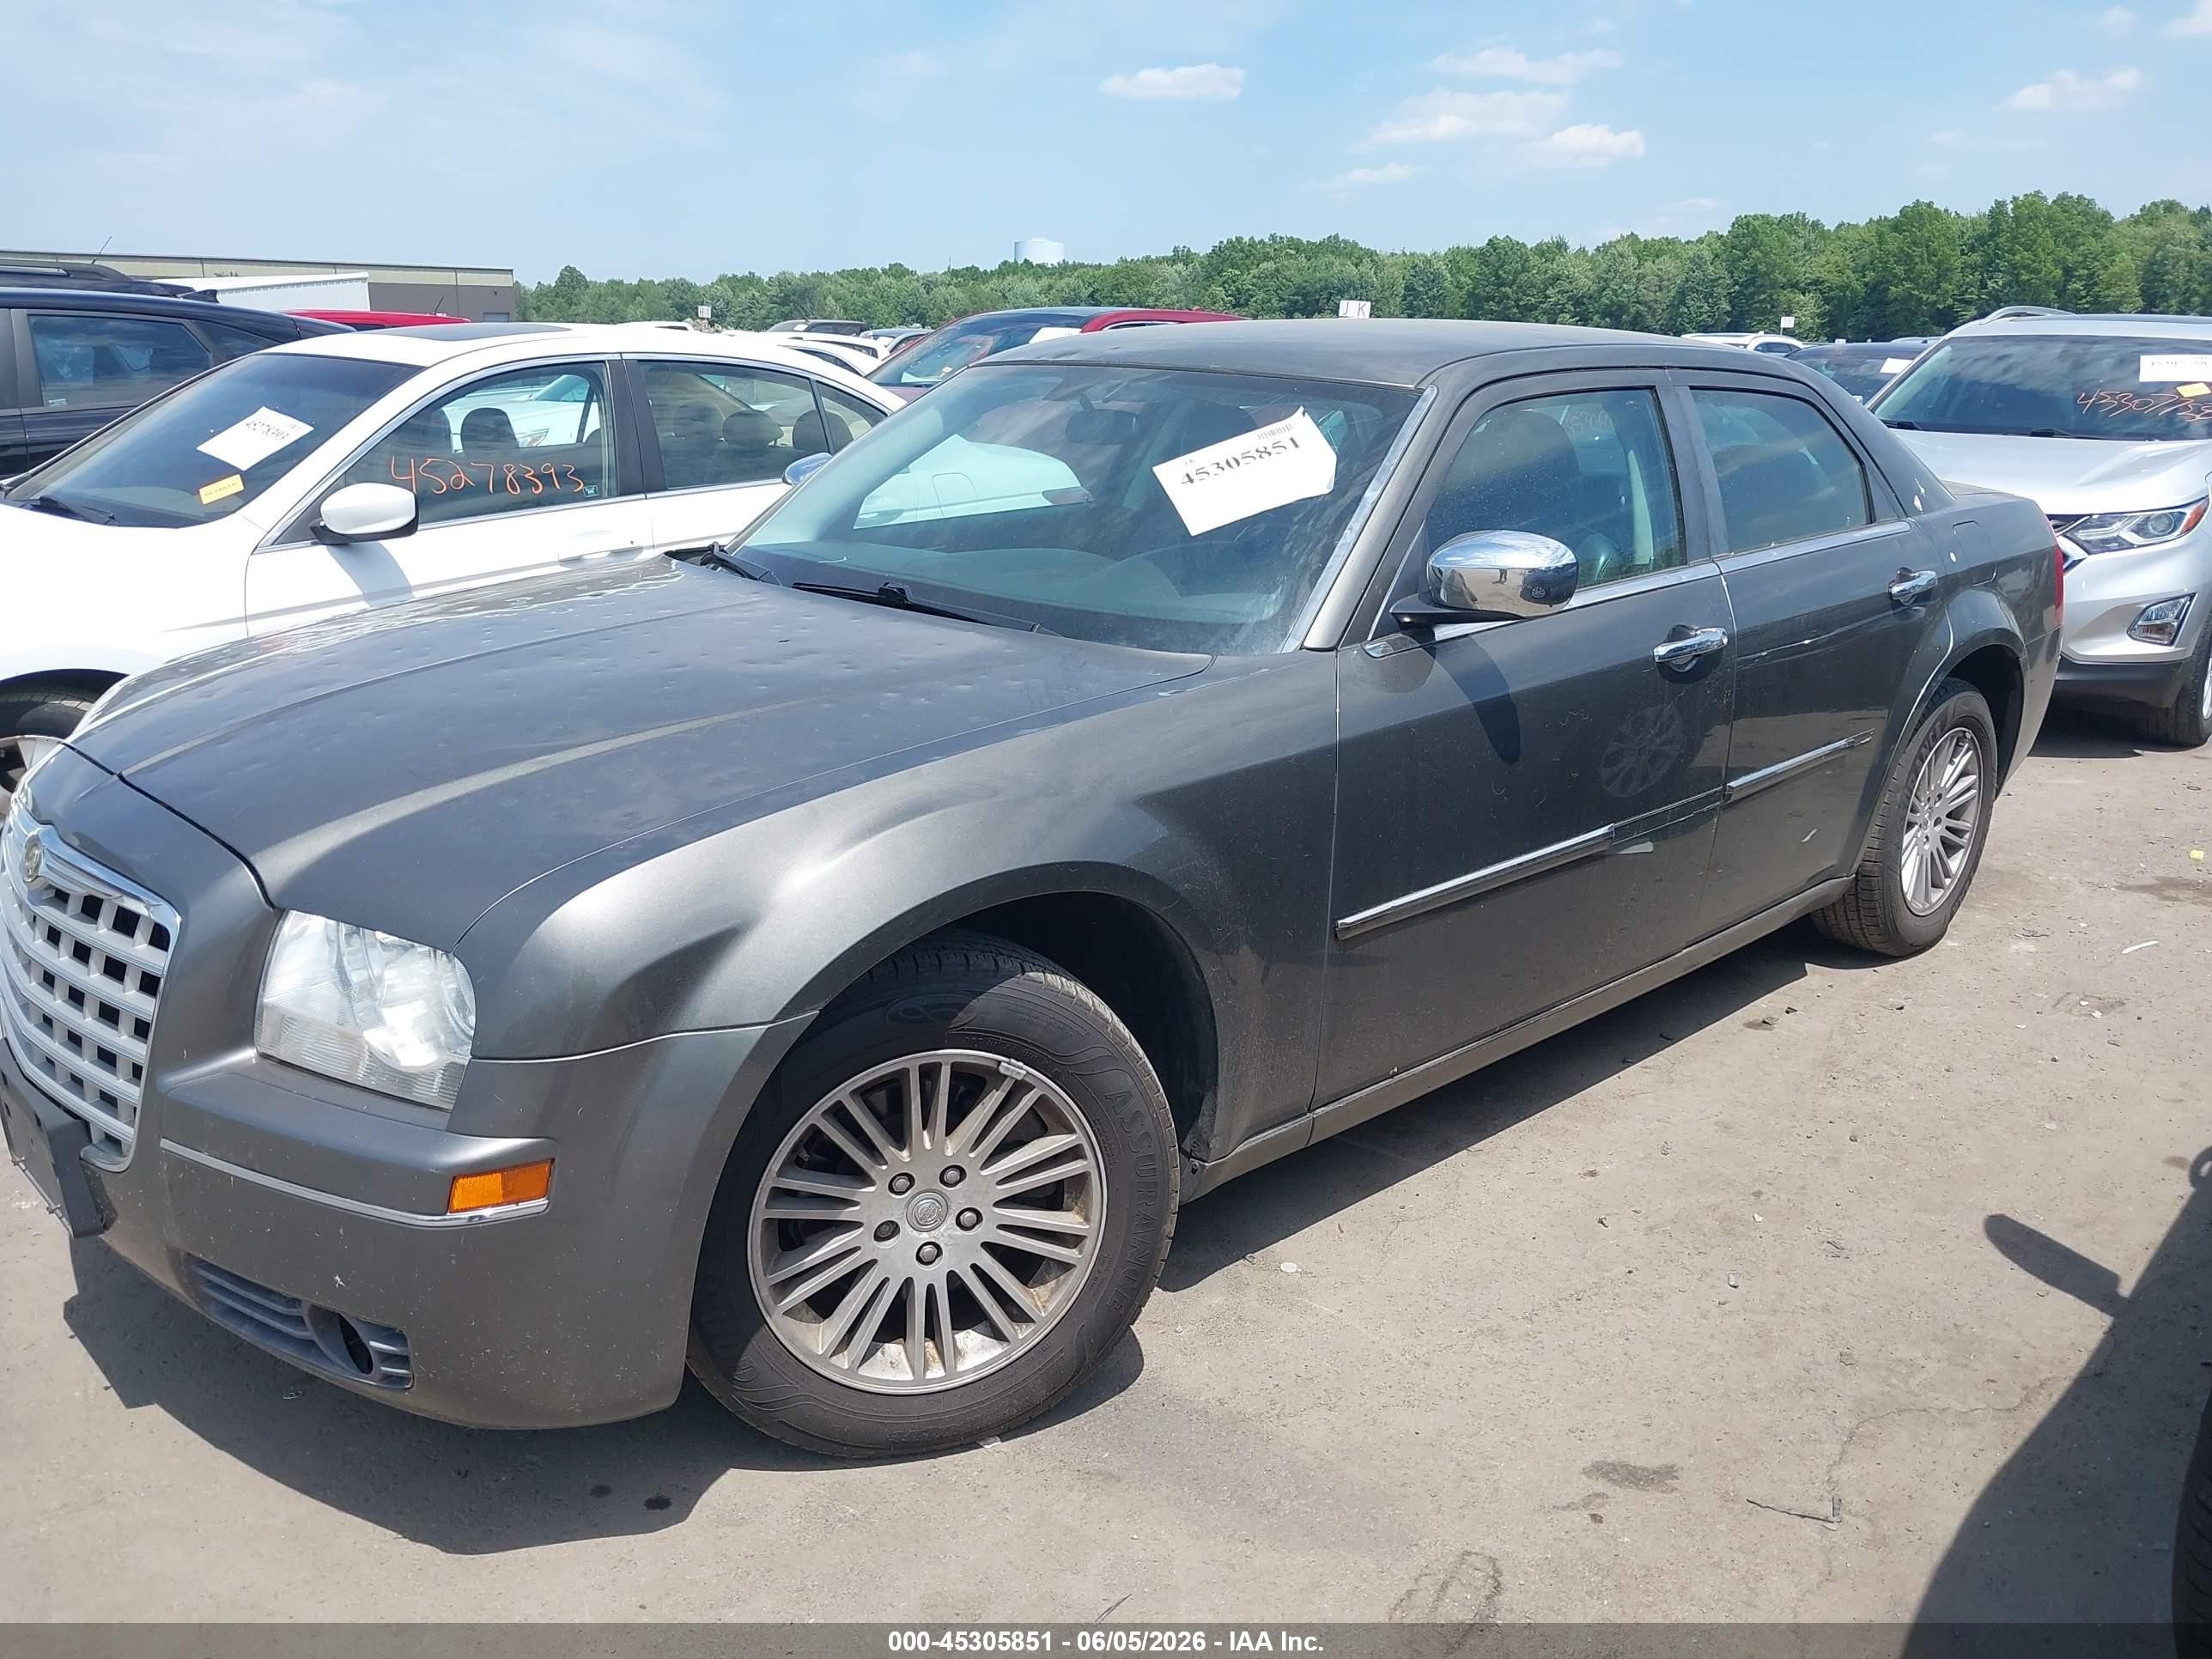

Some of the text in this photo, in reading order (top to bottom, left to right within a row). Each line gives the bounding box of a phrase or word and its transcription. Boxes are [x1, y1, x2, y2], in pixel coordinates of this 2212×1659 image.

[391, 454, 585, 495] 45278393
[1181, 436, 1301, 485] 45305851
[1103, 1089, 1158, 1316] ASSURANCE
